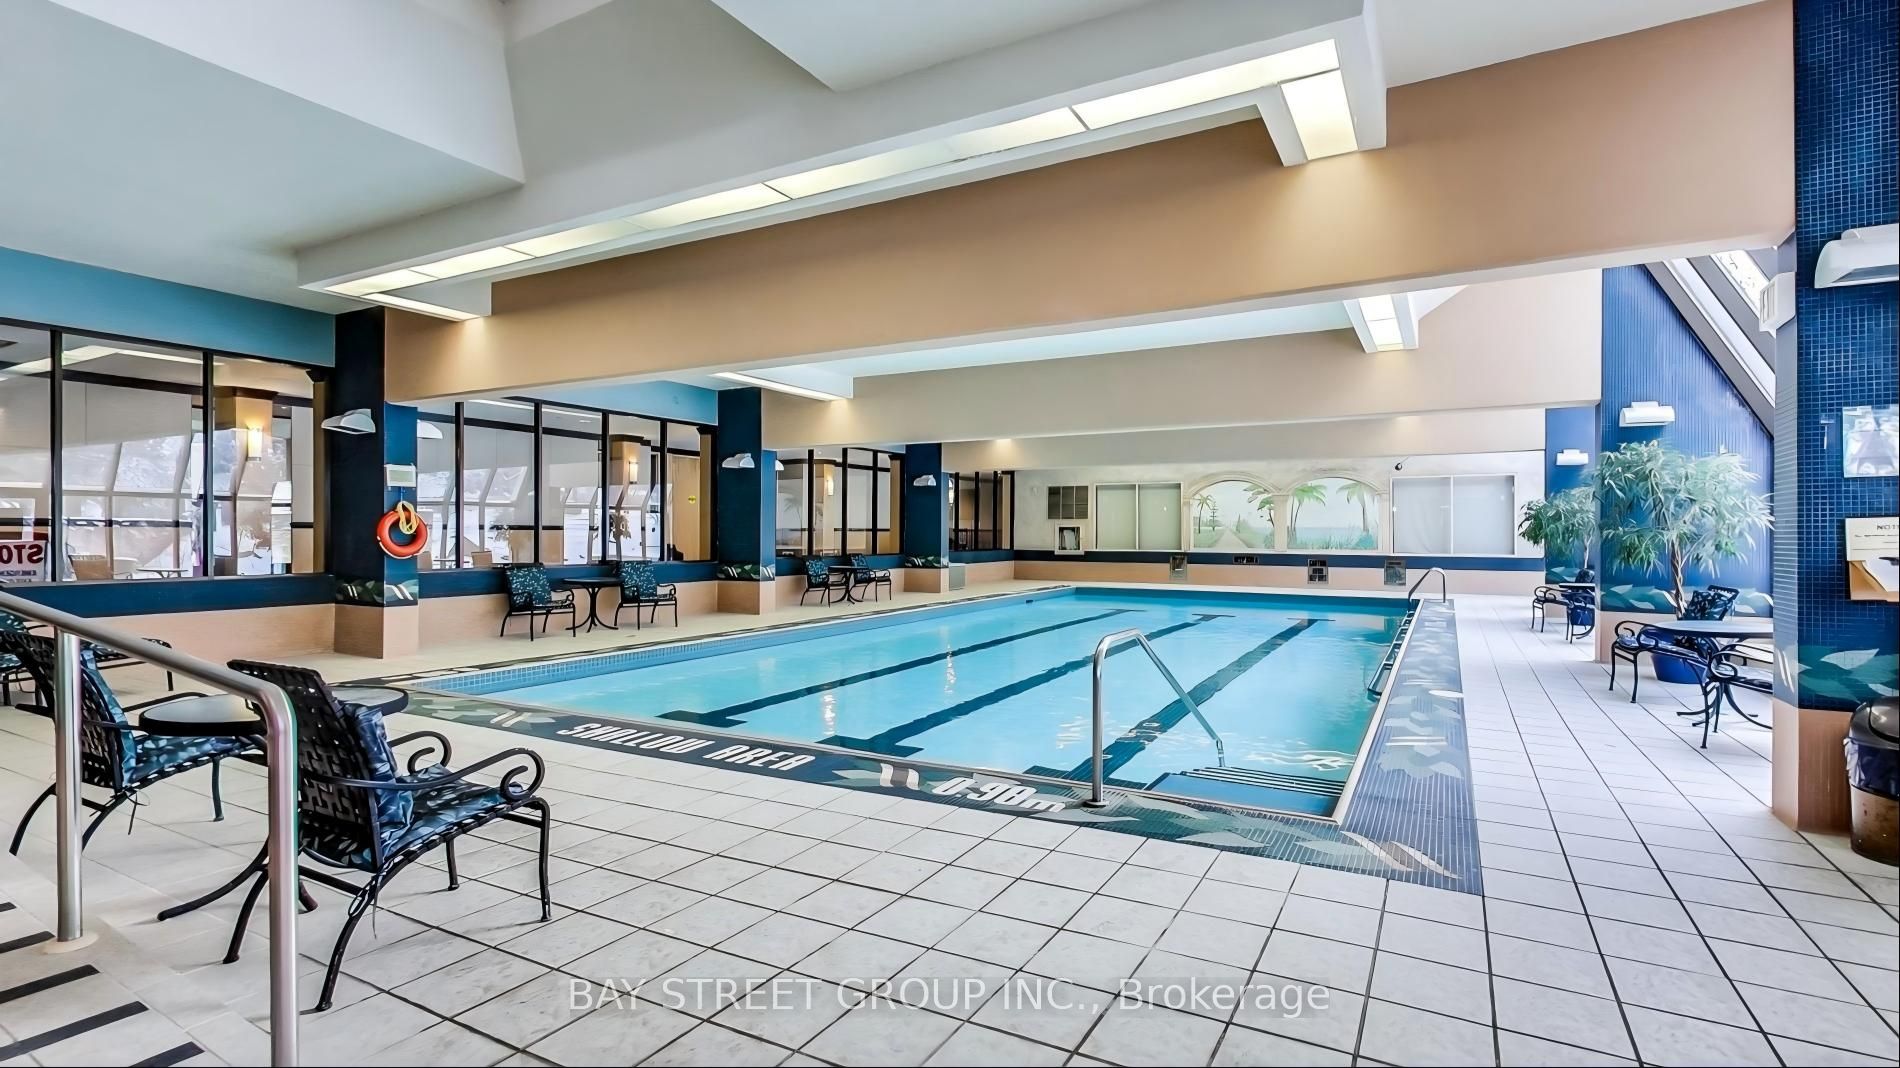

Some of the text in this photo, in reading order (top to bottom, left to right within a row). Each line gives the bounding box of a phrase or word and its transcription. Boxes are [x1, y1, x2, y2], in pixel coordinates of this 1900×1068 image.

[556, 723, 816, 771] SHALLOW AREA
[932, 777, 1066, 813] 0.98m
